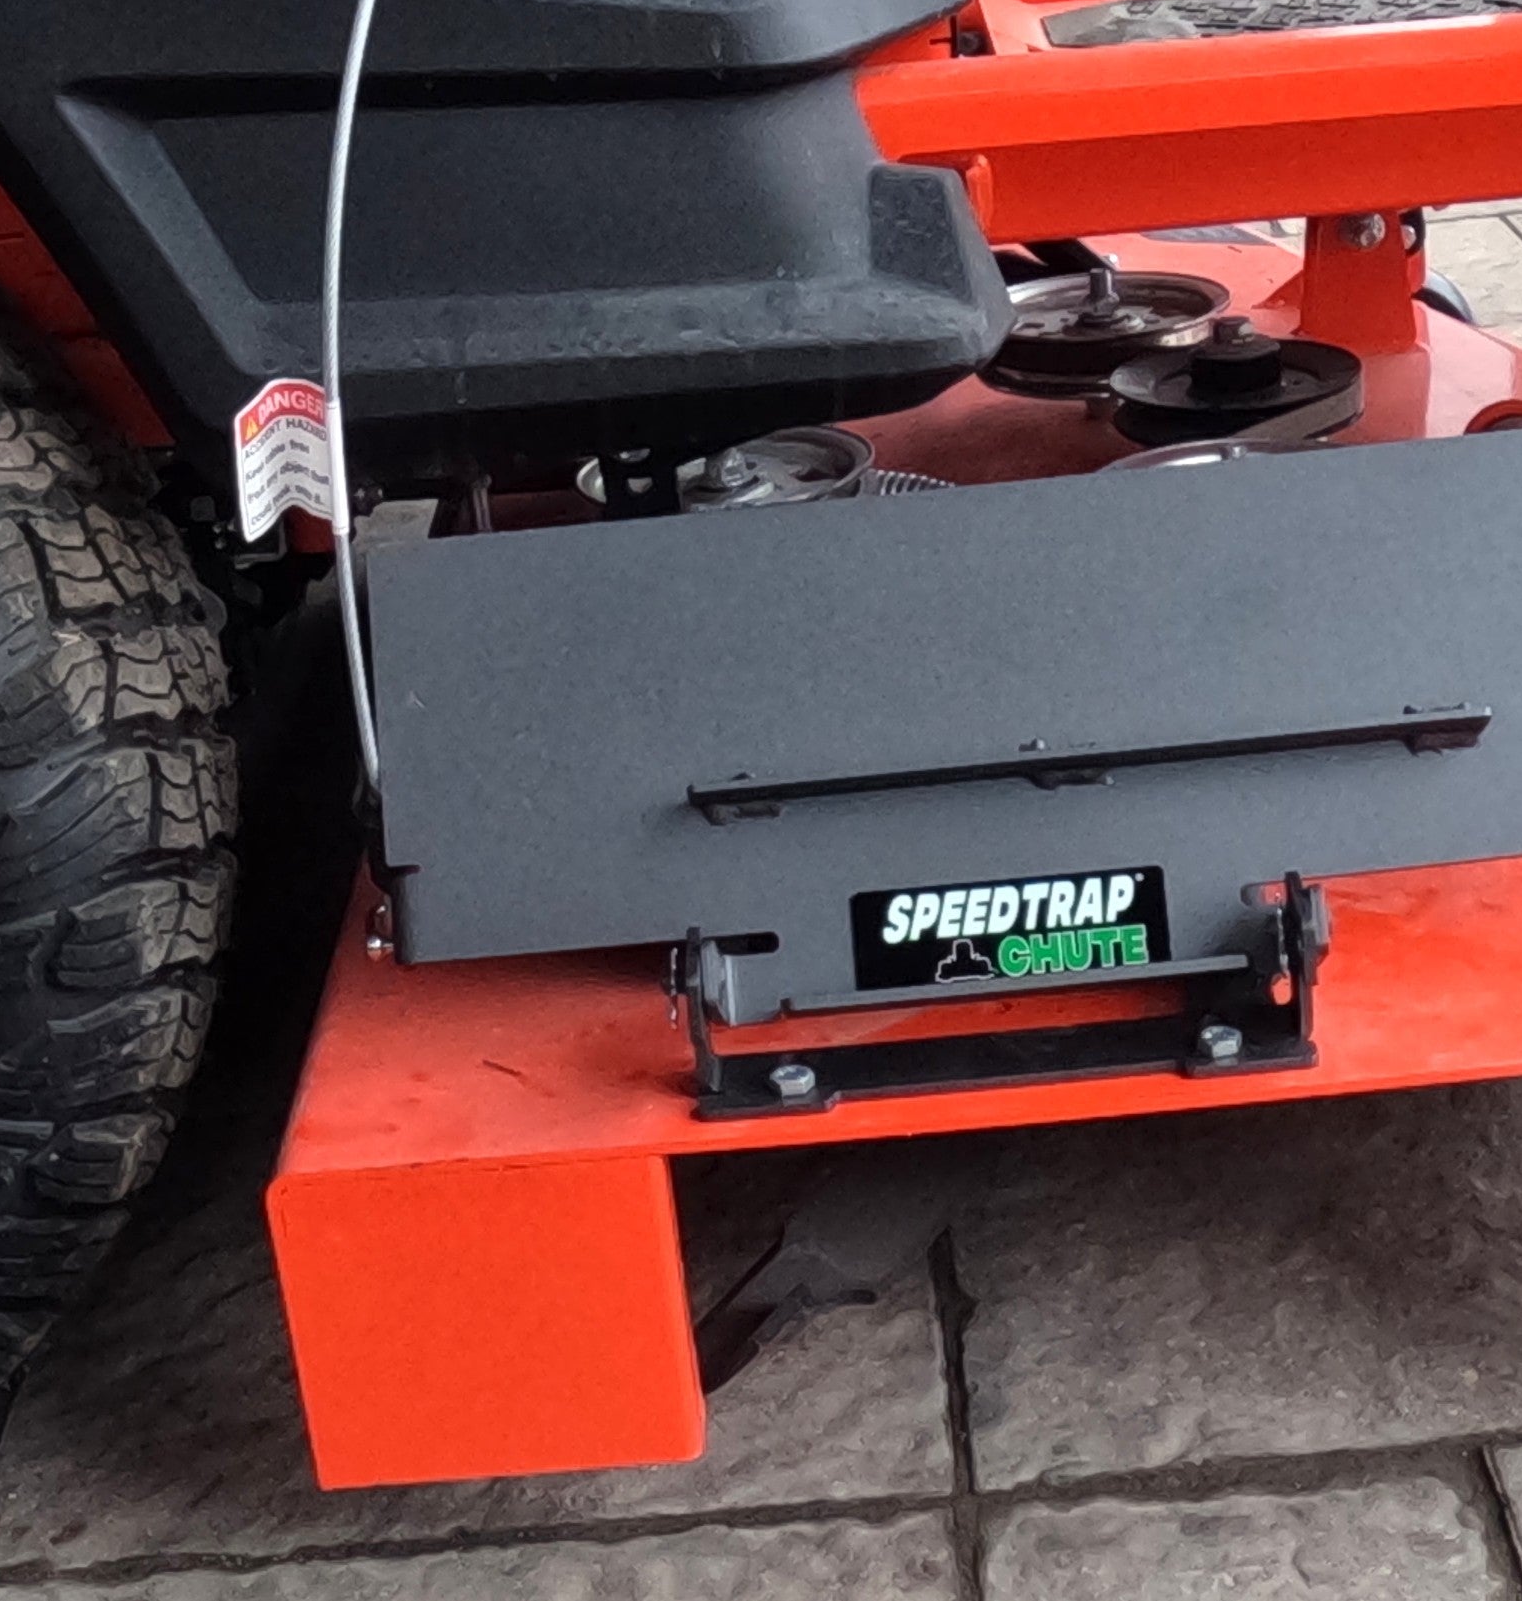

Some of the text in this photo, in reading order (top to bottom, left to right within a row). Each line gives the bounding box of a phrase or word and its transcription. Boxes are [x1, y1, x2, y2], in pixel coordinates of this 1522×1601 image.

[257, 389, 325, 427] DANGER
[881, 874, 1137, 945] SPEEDTRAP
[998, 923, 1149, 978] CHUTE
